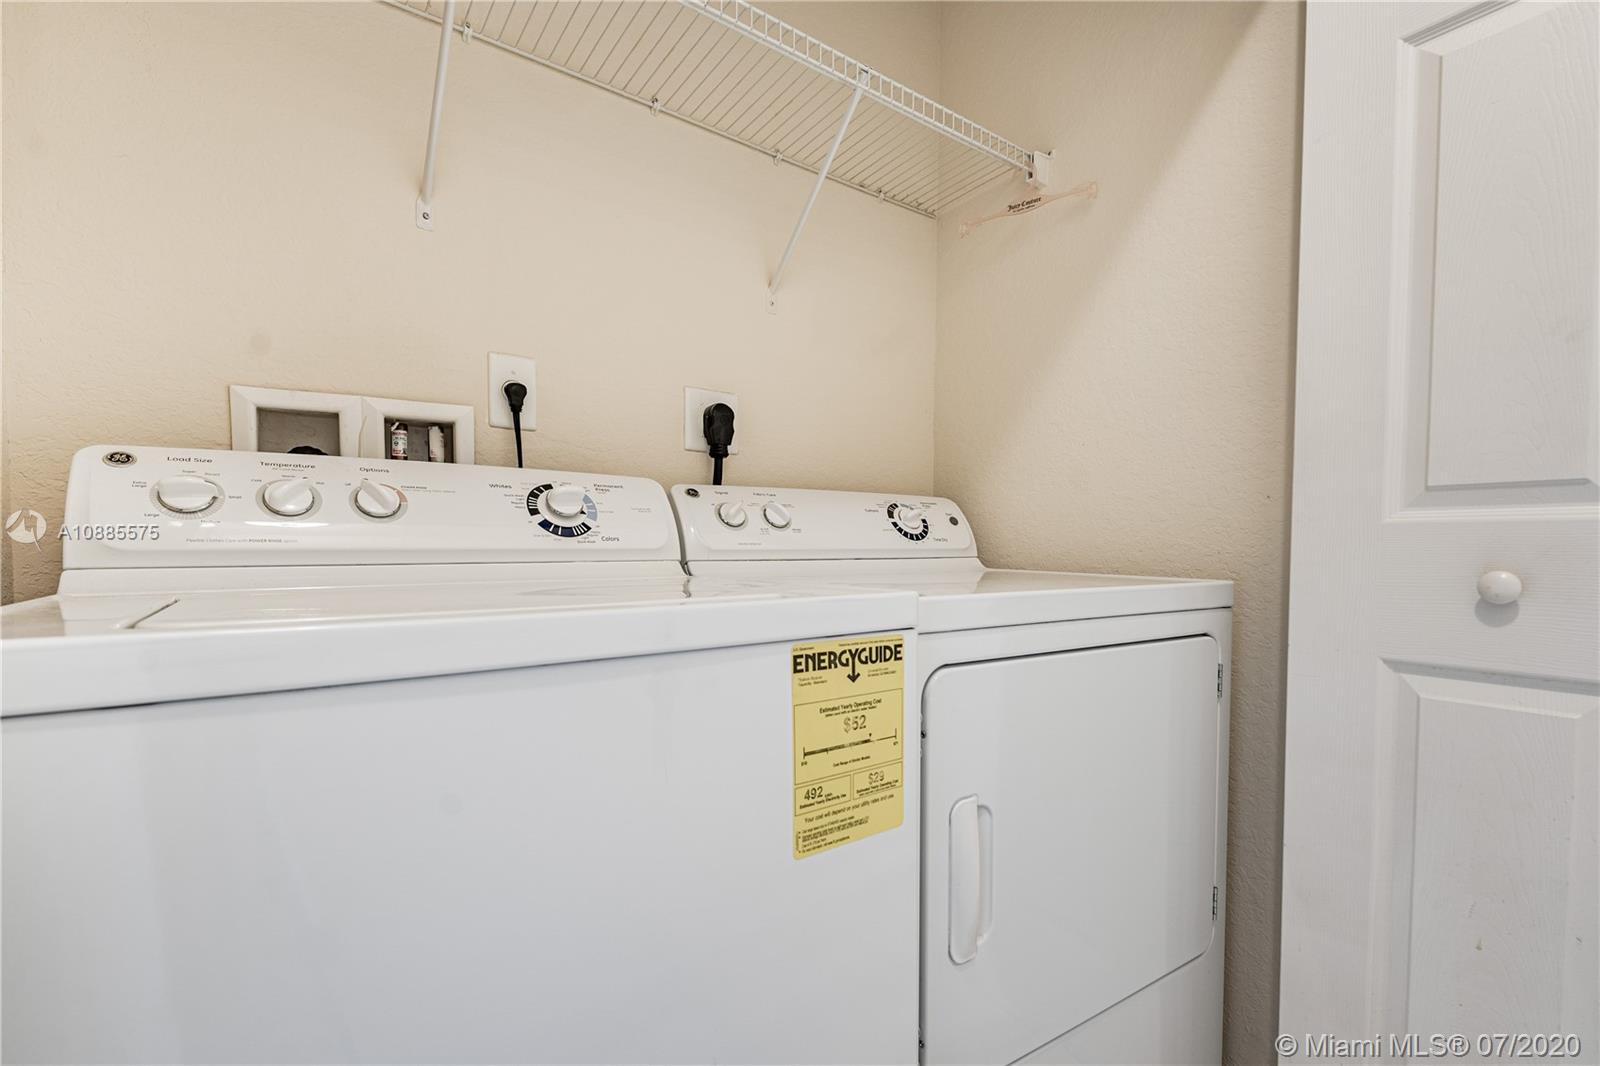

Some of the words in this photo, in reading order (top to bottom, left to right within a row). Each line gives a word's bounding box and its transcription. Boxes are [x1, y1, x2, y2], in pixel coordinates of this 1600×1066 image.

[260, 461, 316, 470] Temperature
[793, 644, 903, 676] ENERGYGUIDE
[819, 706, 840, 714] Estimated
[854, 700, 872, 708] Operating
[844, 714, 867, 734] $52
[804, 786, 824, 801] 492
[831, 808, 846, 816] depend
